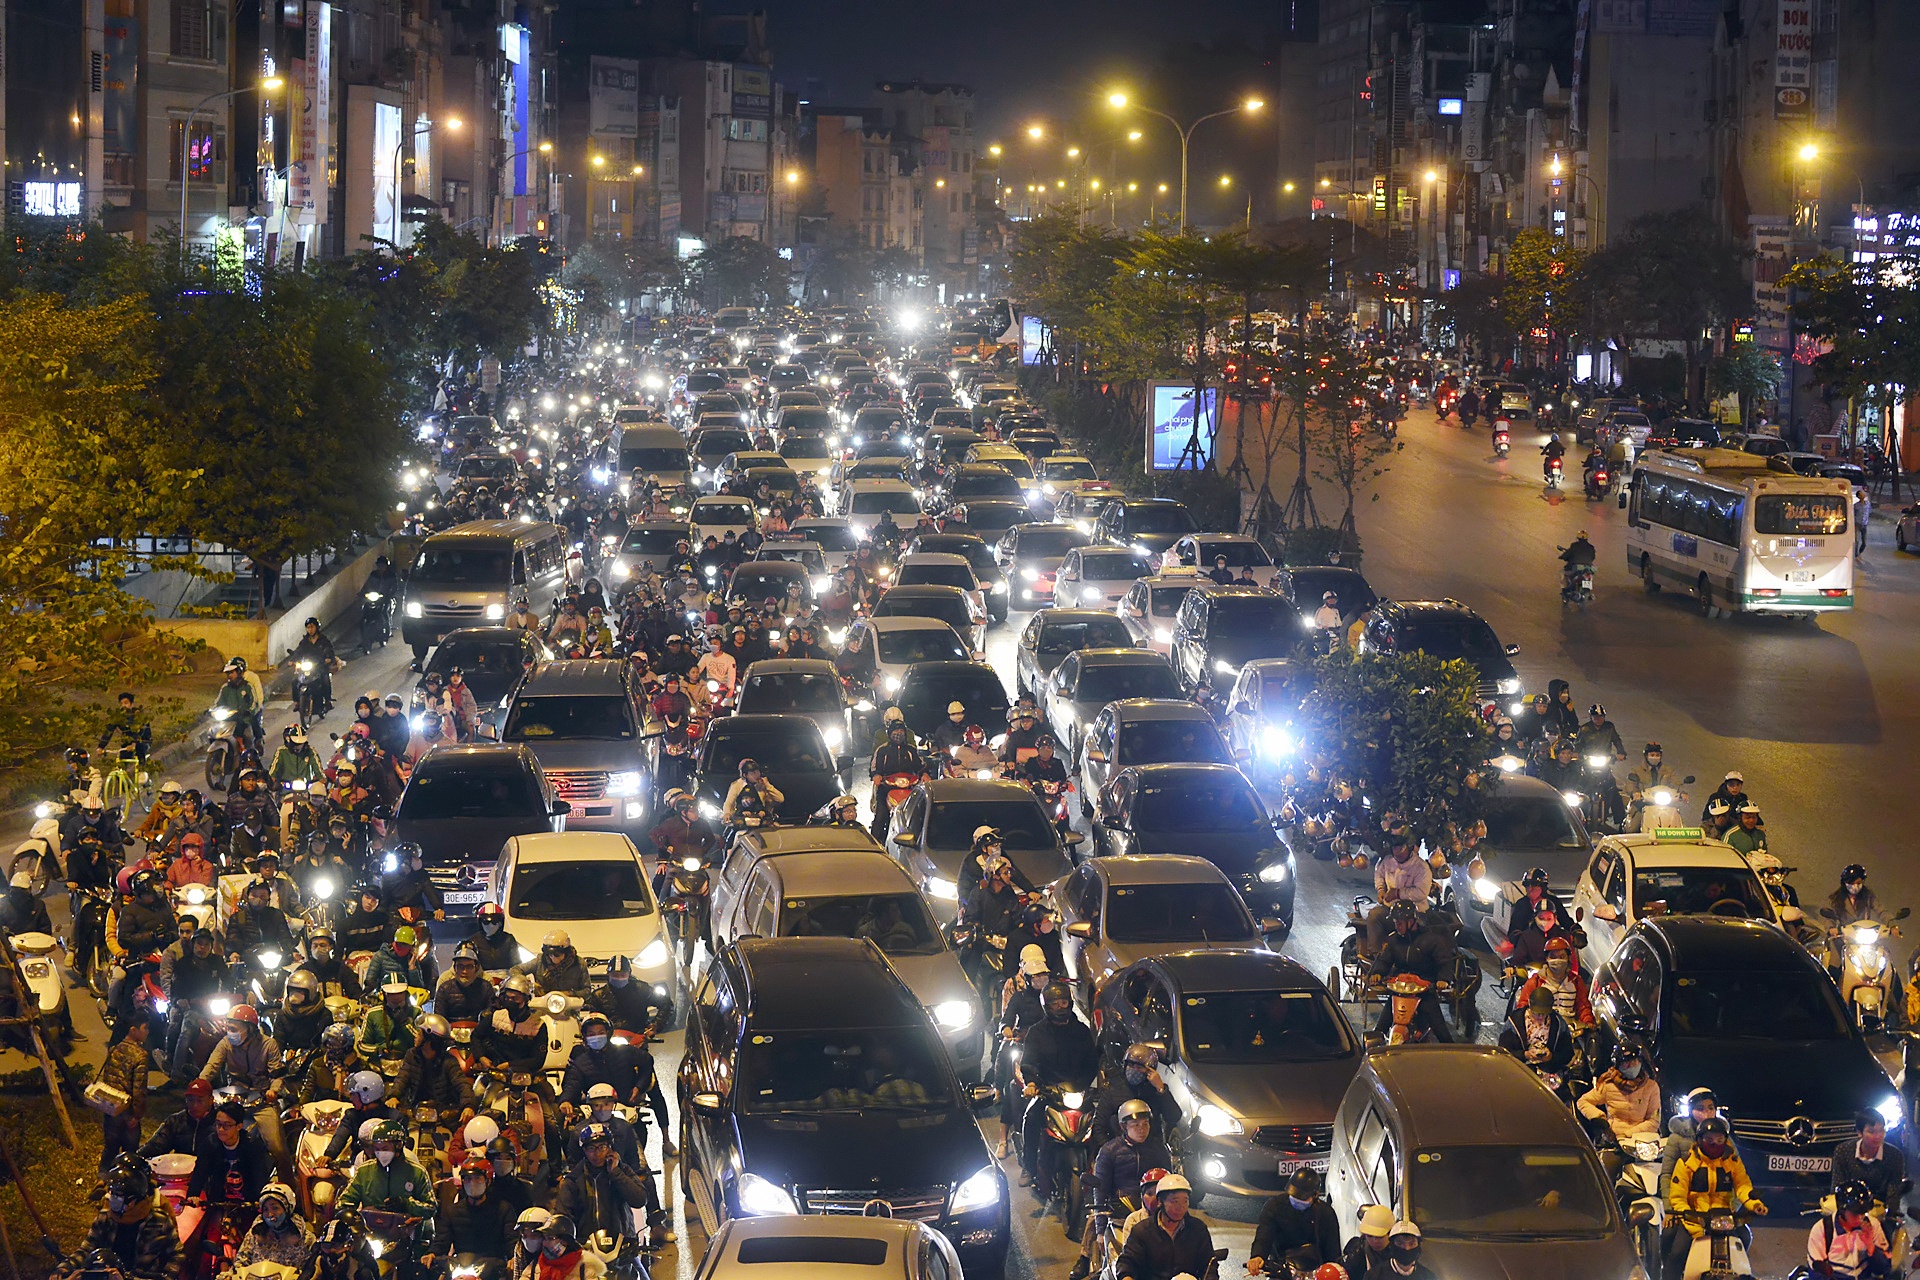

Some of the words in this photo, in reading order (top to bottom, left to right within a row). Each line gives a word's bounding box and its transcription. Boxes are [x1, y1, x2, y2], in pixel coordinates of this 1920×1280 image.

[1783, 9, 1808, 25] BƠM
[1779, 30, 1811, 50] NƯỚC
[708, 661, 725, 677] 25
[1770, 1157, 1831, 1171] 89A-092.70
